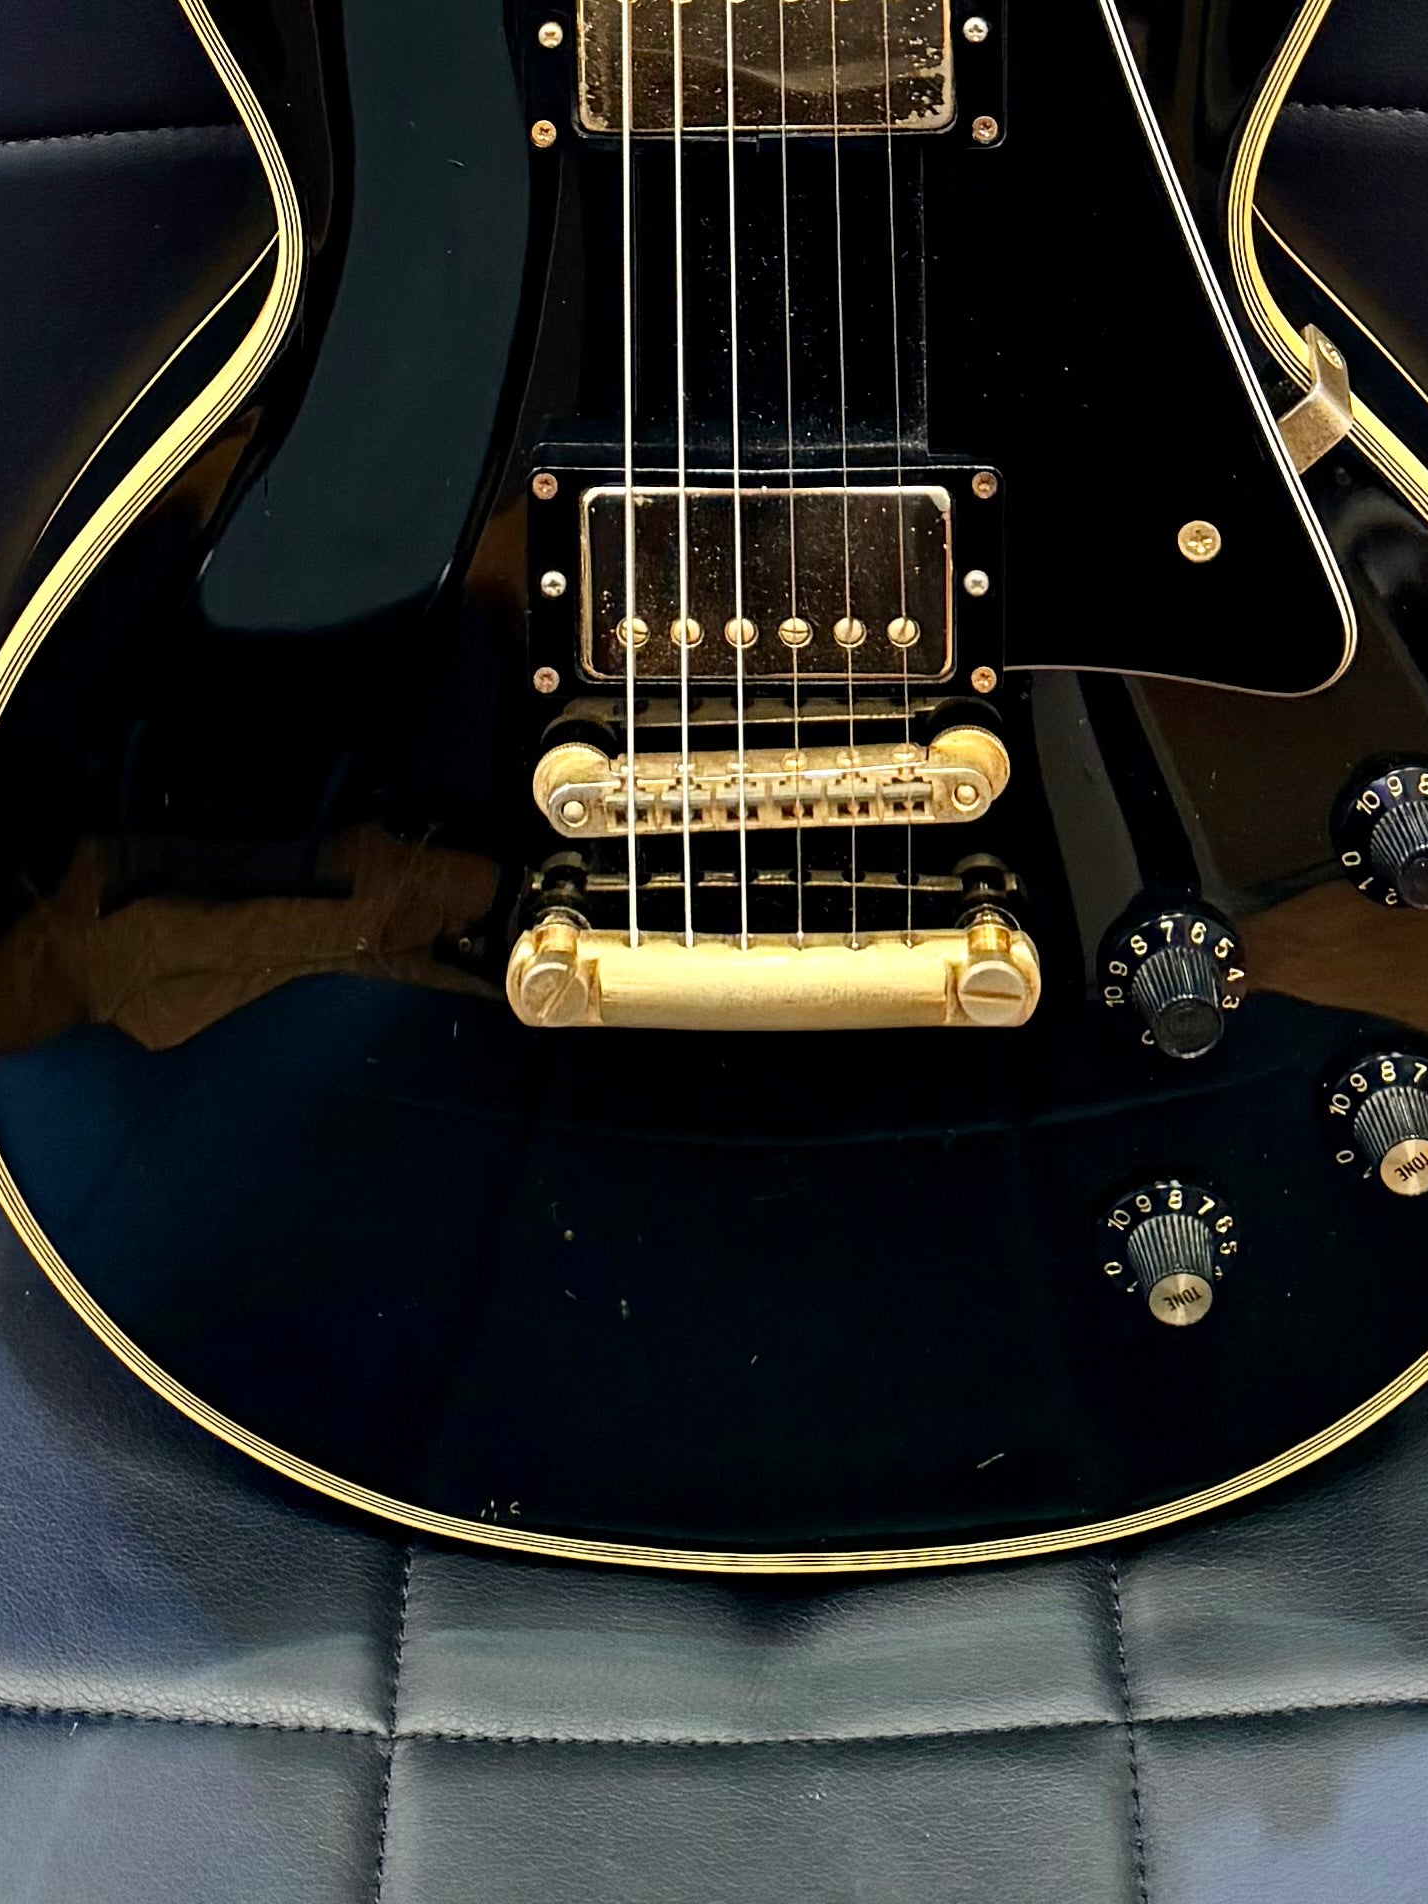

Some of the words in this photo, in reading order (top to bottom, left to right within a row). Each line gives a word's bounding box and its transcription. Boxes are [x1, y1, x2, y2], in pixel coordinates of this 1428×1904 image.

[1356, 790, 1380, 815] 10
[1386, 775, 1403, 797] 9
[1341, 850, 1361, 867] 0
[1358, 876, 1374, 890] 1
[1160, 921, 1174, 942] 7
[1191, 922, 1207, 944] 6
[1130, 935, 1148, 955] 8
[1214, 937, 1234, 958] 5
[1109, 960, 1128, 977] 9
[1227, 967, 1245, 982] 4
[1104, 985, 1125, 1007] 10
[1222, 995, 1239, 1009] 3
[1329, 1093, 1351, 1116] 10
[1349, 1073, 1368, 1092] 9
[1381, 1060, 1396, 1082] 8
[1413, 1062, 1427, 1083] 7
[1336, 1150, 1355, 1164] 0
[1135, 1195, 1152, 1213] 9
[1168, 1189, 1183, 1210] 8
[1198, 1195, 1215, 1215] 7
[1108, 1209, 1131, 1231] 10
[1215, 1215, 1233, 1233] 6
[1220, 1241, 1237, 1255] 5
[1104, 1261, 1123, 1276] 0
[1162, 1287, 1202, 1311] TONE
